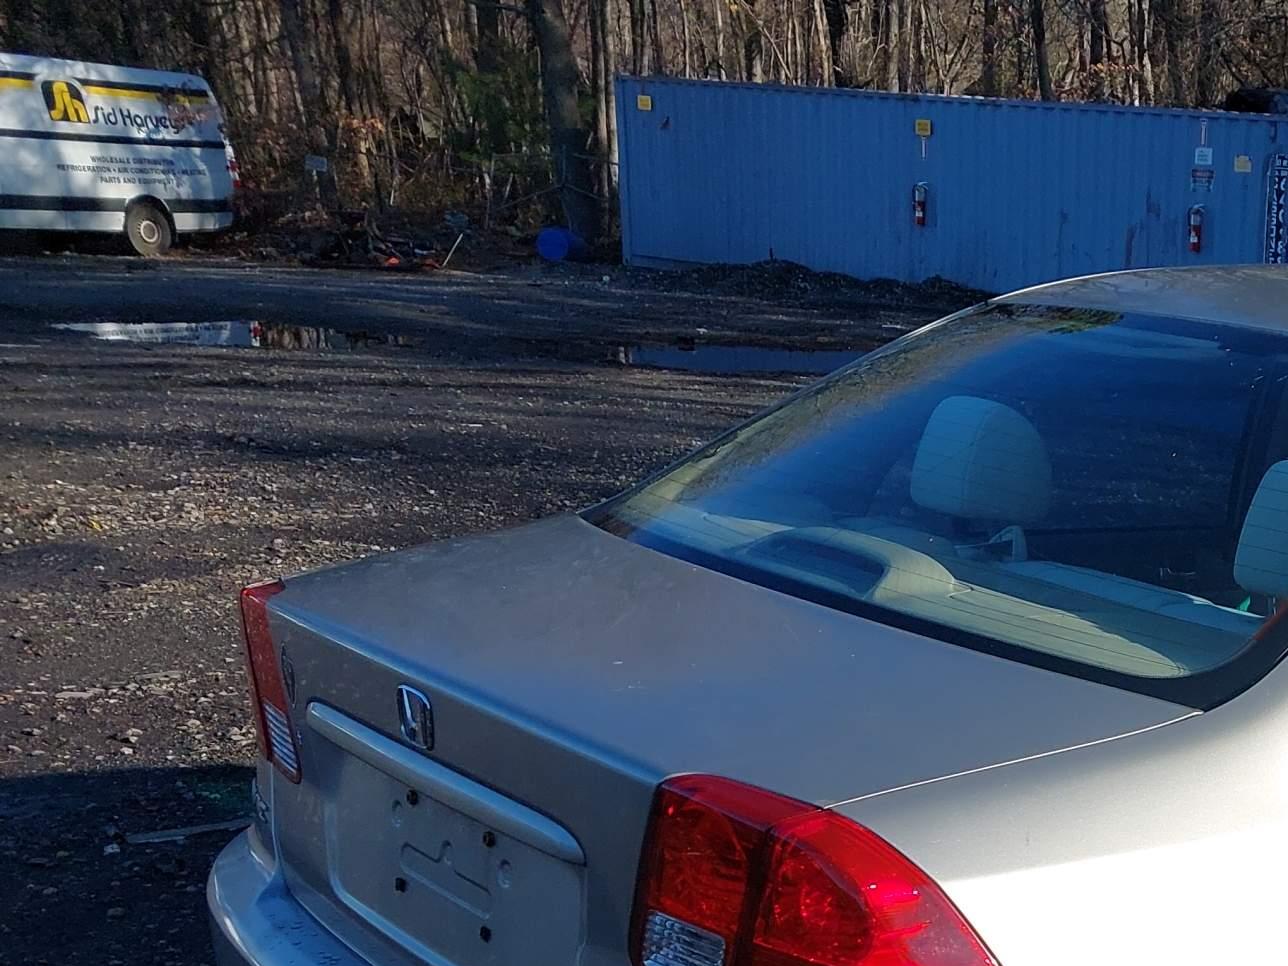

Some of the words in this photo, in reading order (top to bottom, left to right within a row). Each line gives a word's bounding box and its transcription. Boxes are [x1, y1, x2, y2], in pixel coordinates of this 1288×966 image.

[92, 105, 118, 126] Sid
[90, 155, 130, 165] WHOLESALE
[56, 164, 113, 174] REFRIGERATION
[100, 176, 121, 184] PARTS
